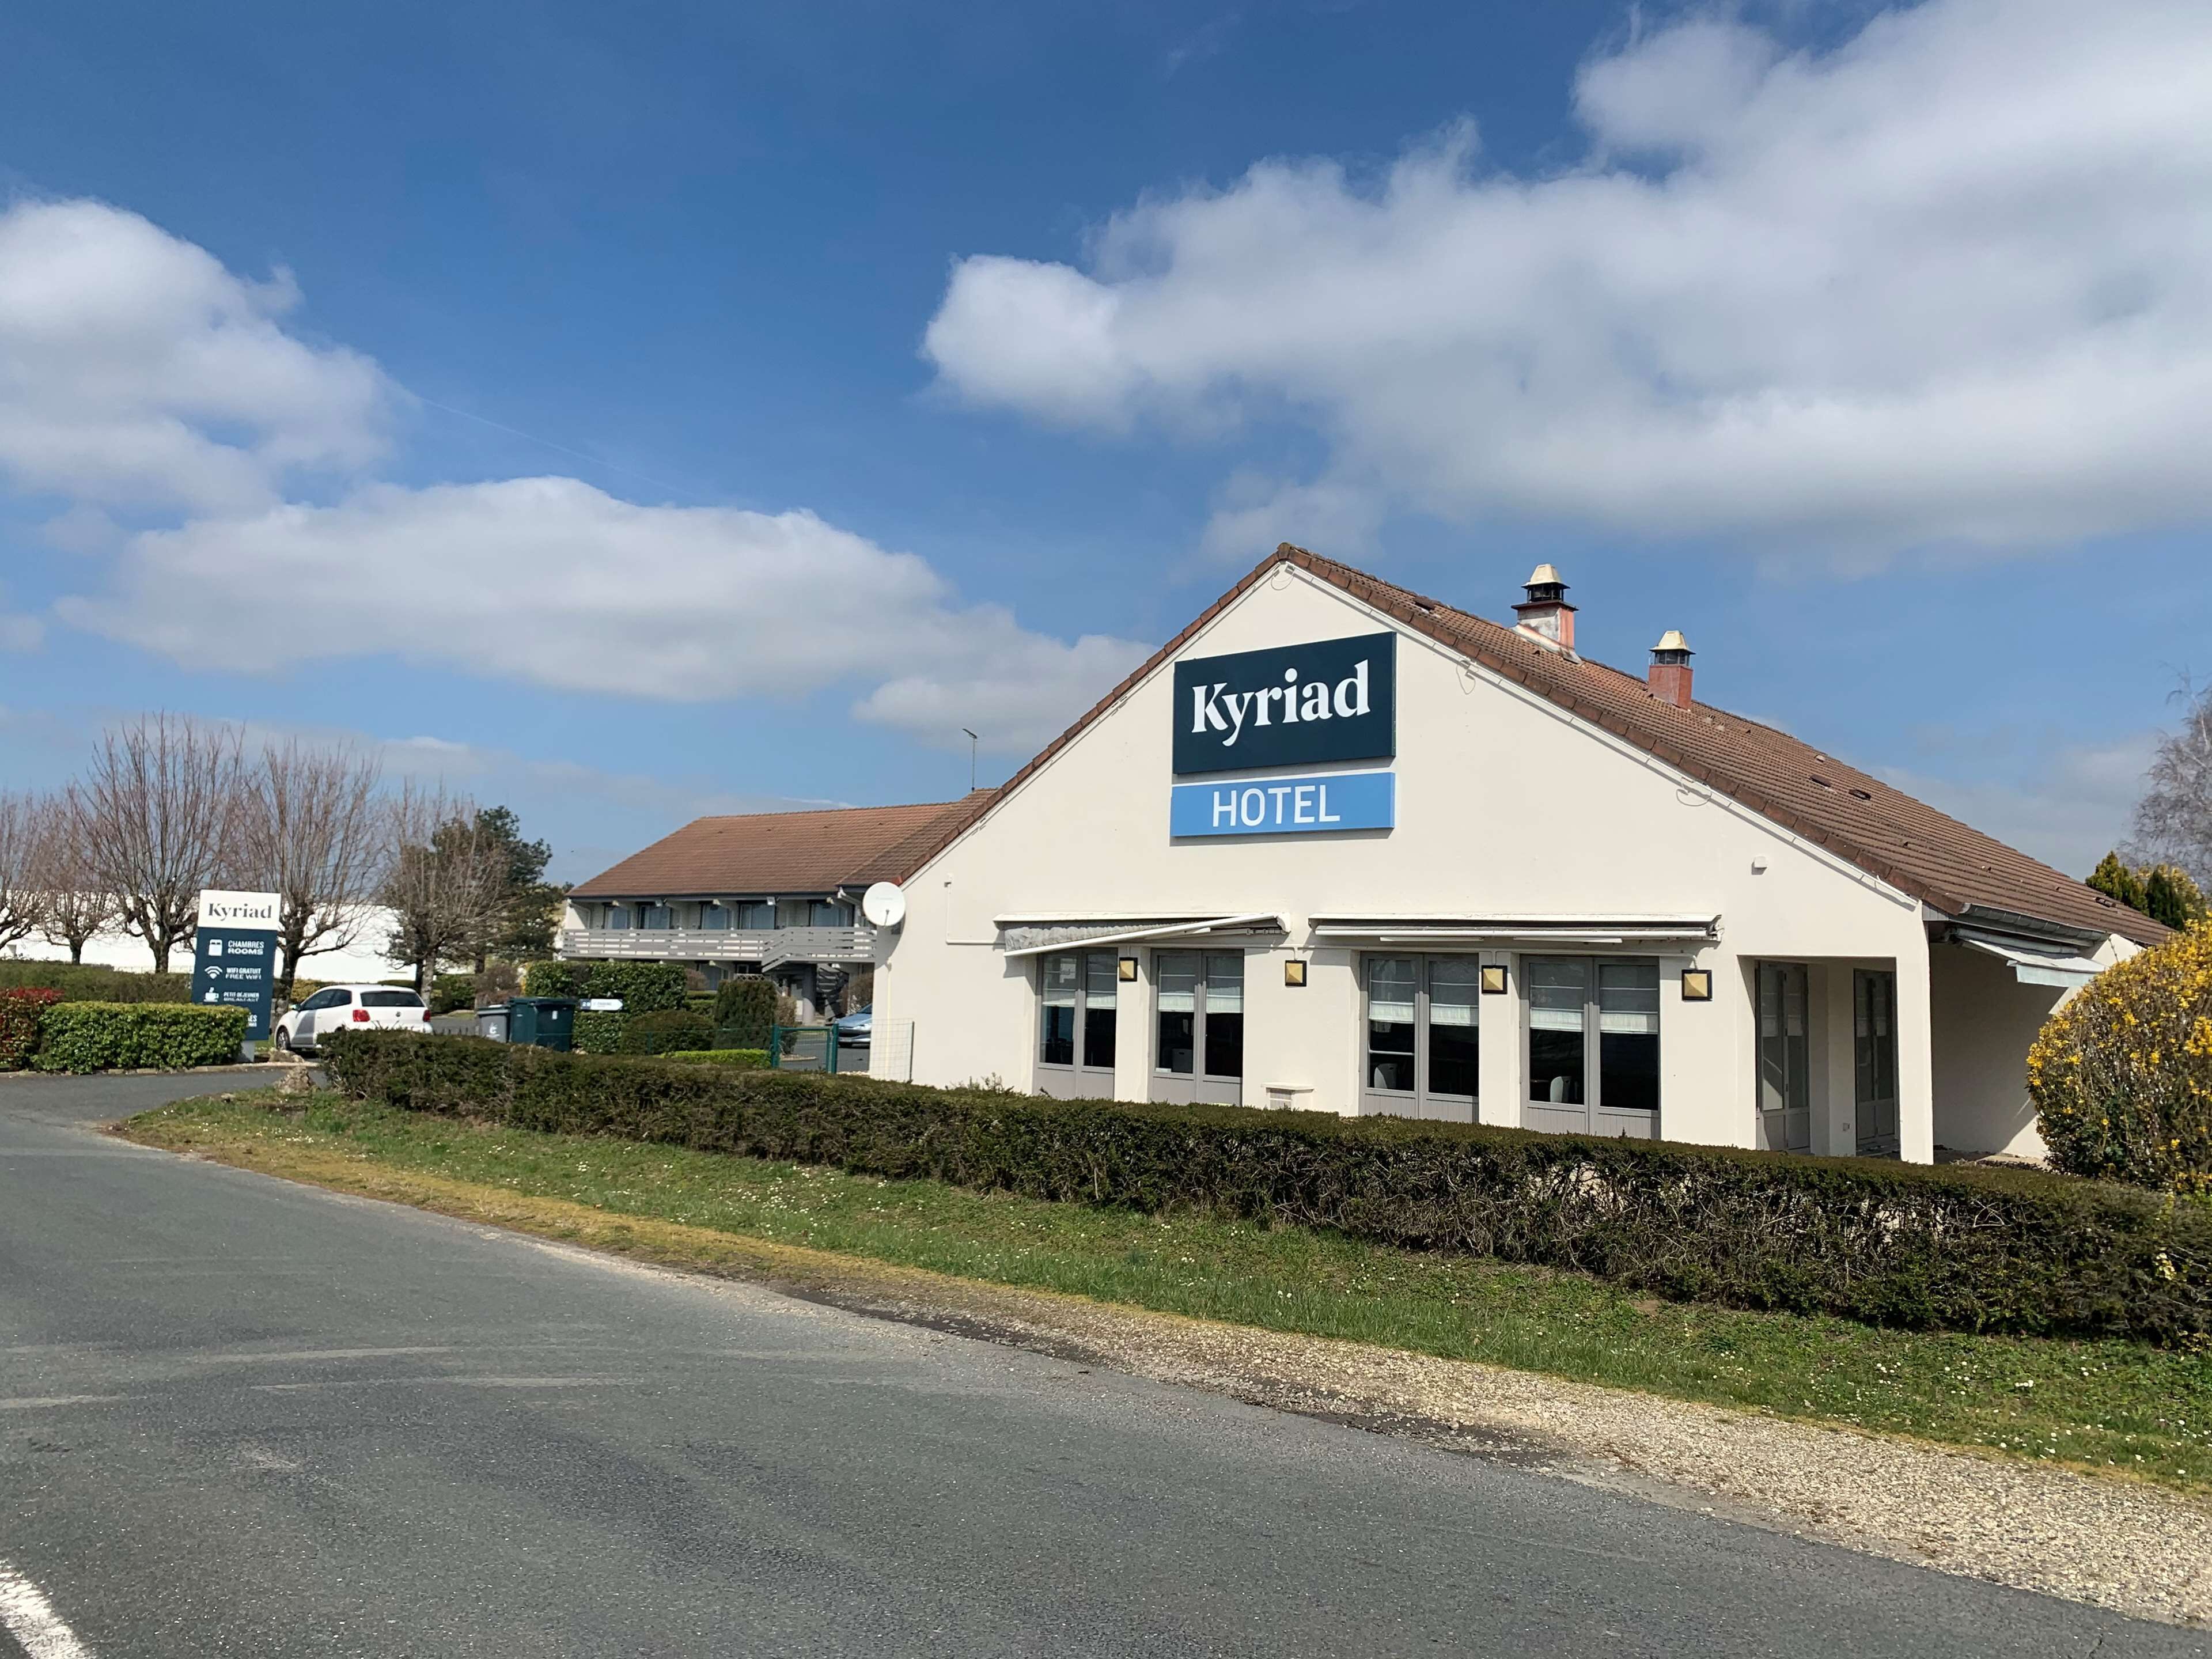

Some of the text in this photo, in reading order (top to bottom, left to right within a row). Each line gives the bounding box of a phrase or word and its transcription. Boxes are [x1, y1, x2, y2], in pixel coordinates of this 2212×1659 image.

[1191, 658, 1371, 747] Kyriad
[1212, 784, 1341, 827] HOTEL
[209, 903, 272, 921] Kyriad
[228, 940, 264, 949] CHAMBRES
[228, 948, 263, 956] ROOMS
